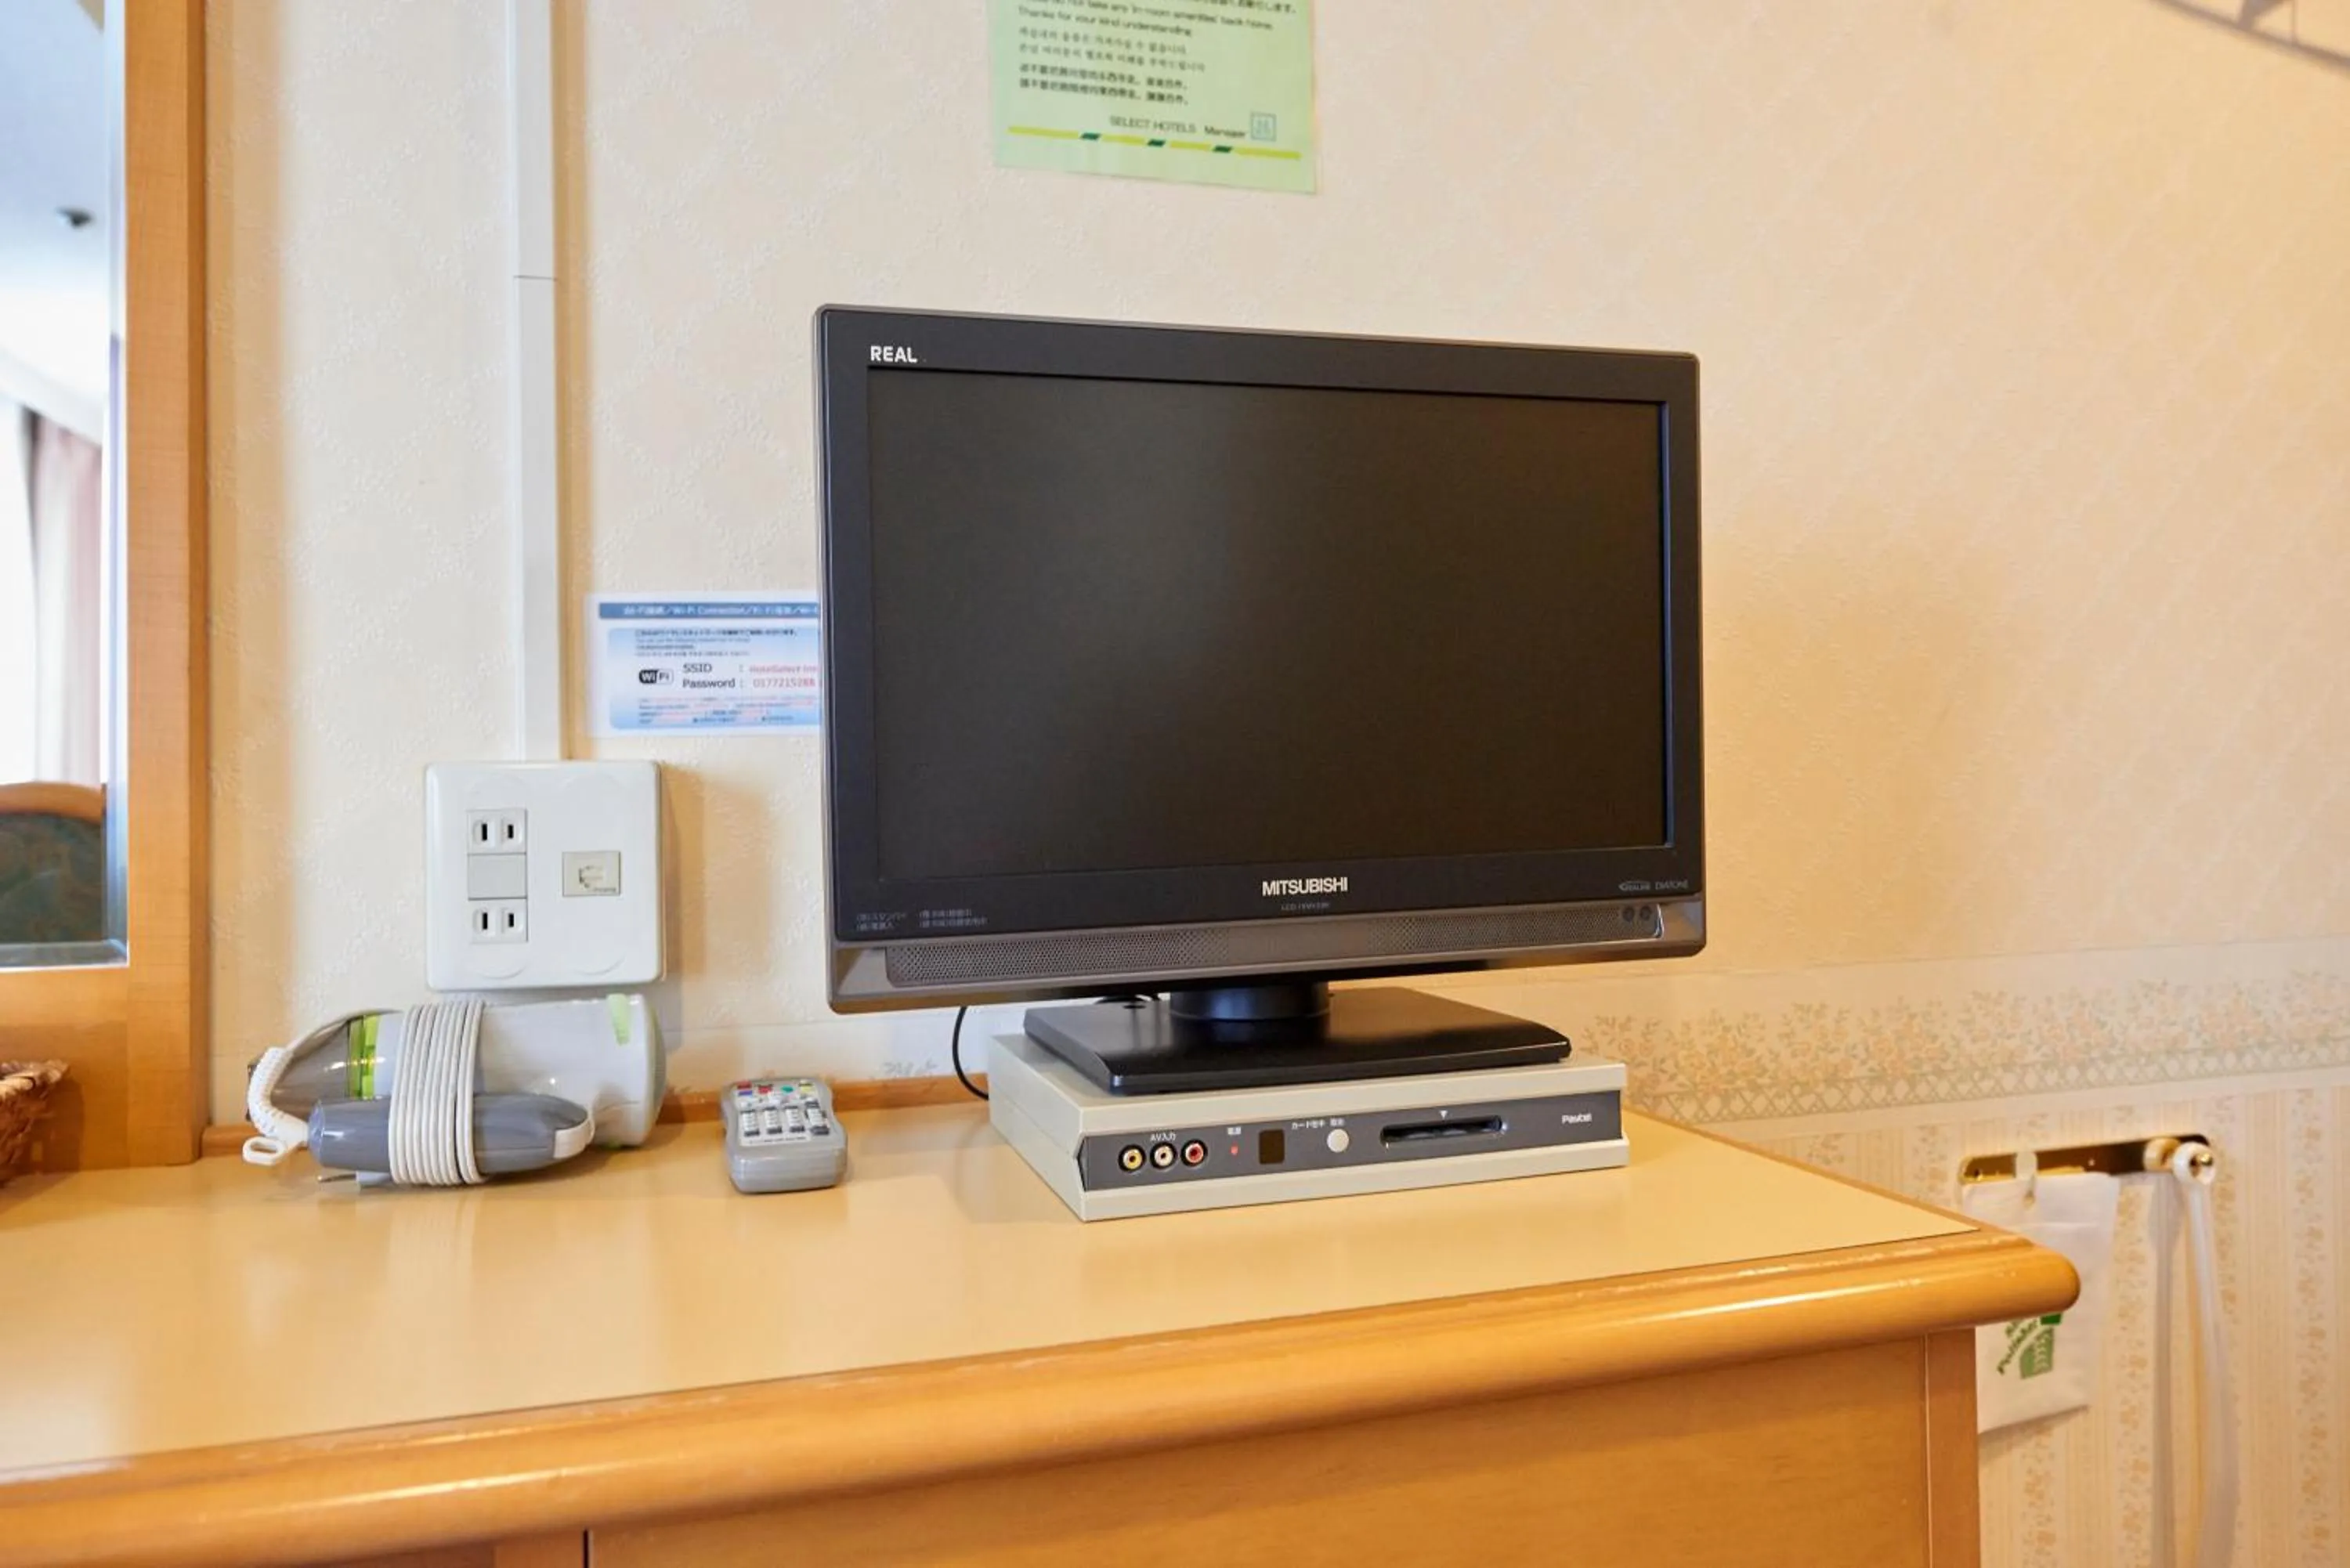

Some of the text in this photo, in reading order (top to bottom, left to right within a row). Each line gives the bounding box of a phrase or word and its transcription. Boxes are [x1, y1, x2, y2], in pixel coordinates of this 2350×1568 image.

[1153, 120, 1196, 134] HOTELS
[870, 345, 918, 363] REAL
[682, 663, 712, 674] SSID
[682, 677, 736, 688] Password
[1262, 876, 1348, 897] MITSUBISHI
